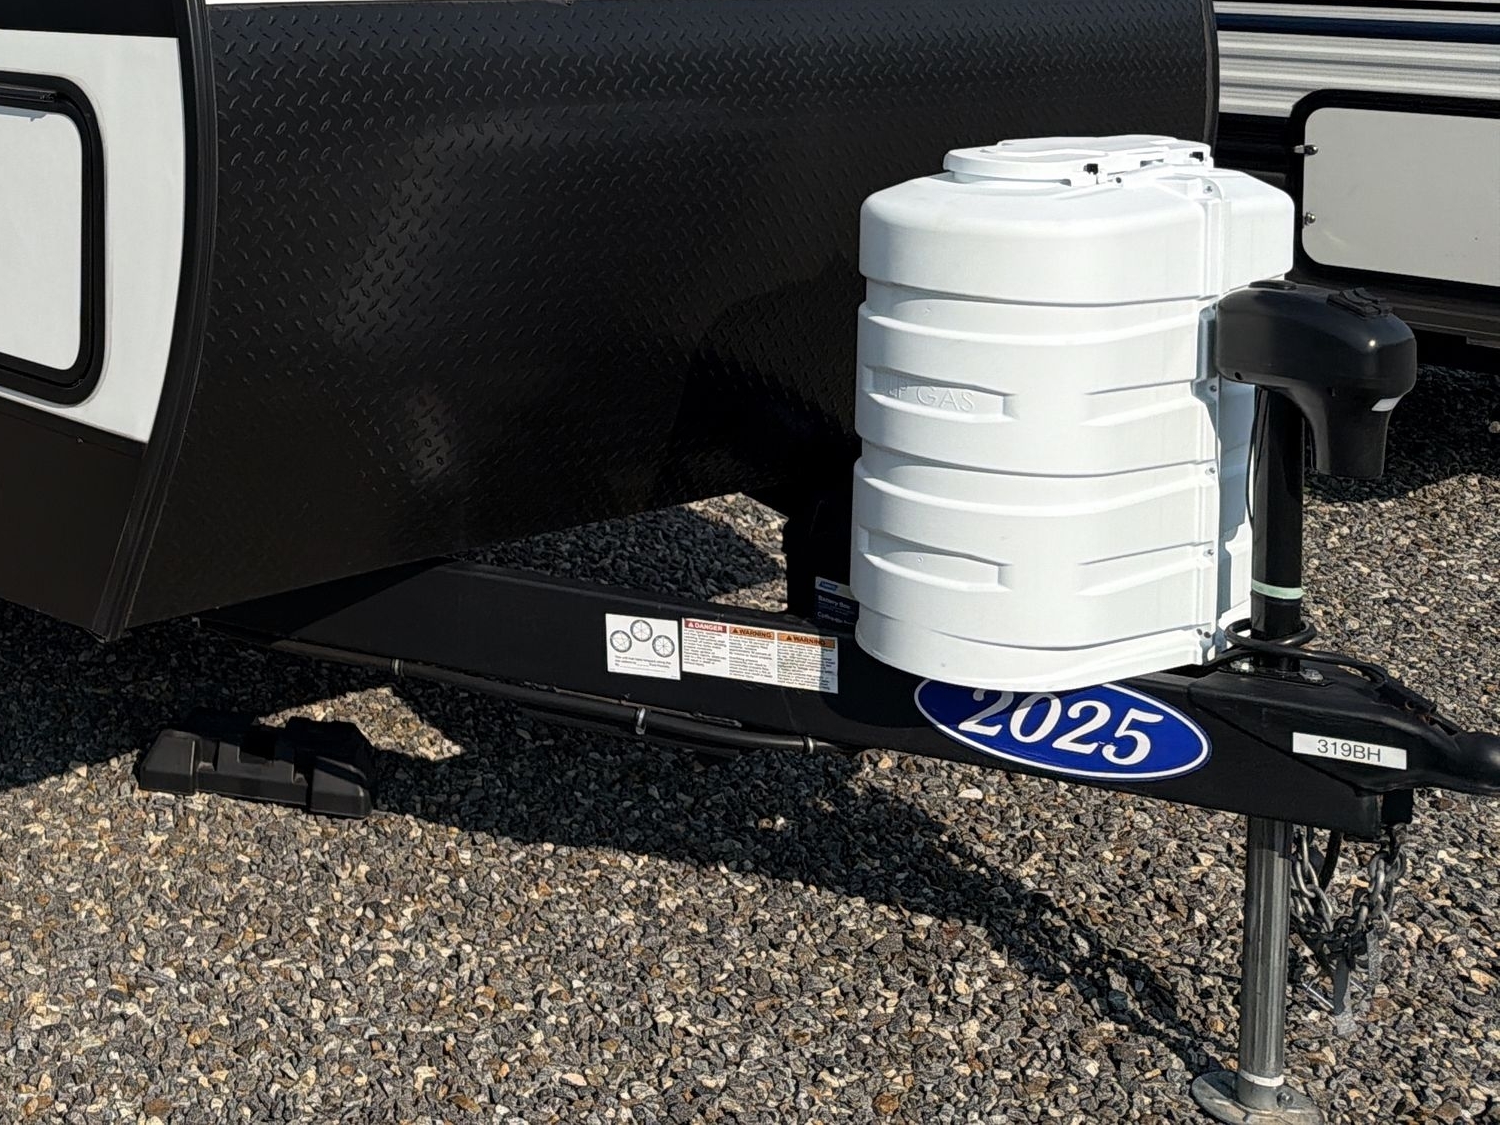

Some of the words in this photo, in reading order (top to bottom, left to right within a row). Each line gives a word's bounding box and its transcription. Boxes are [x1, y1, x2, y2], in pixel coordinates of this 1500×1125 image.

[916, 385, 975, 413] GAS
[694, 622, 723, 632] DANGER
[739, 628, 772, 639] WARNING
[793, 635, 826, 646] WARNING
[958, 689, 1164, 766] 2025
[1317, 739, 1382, 763] 319BH
